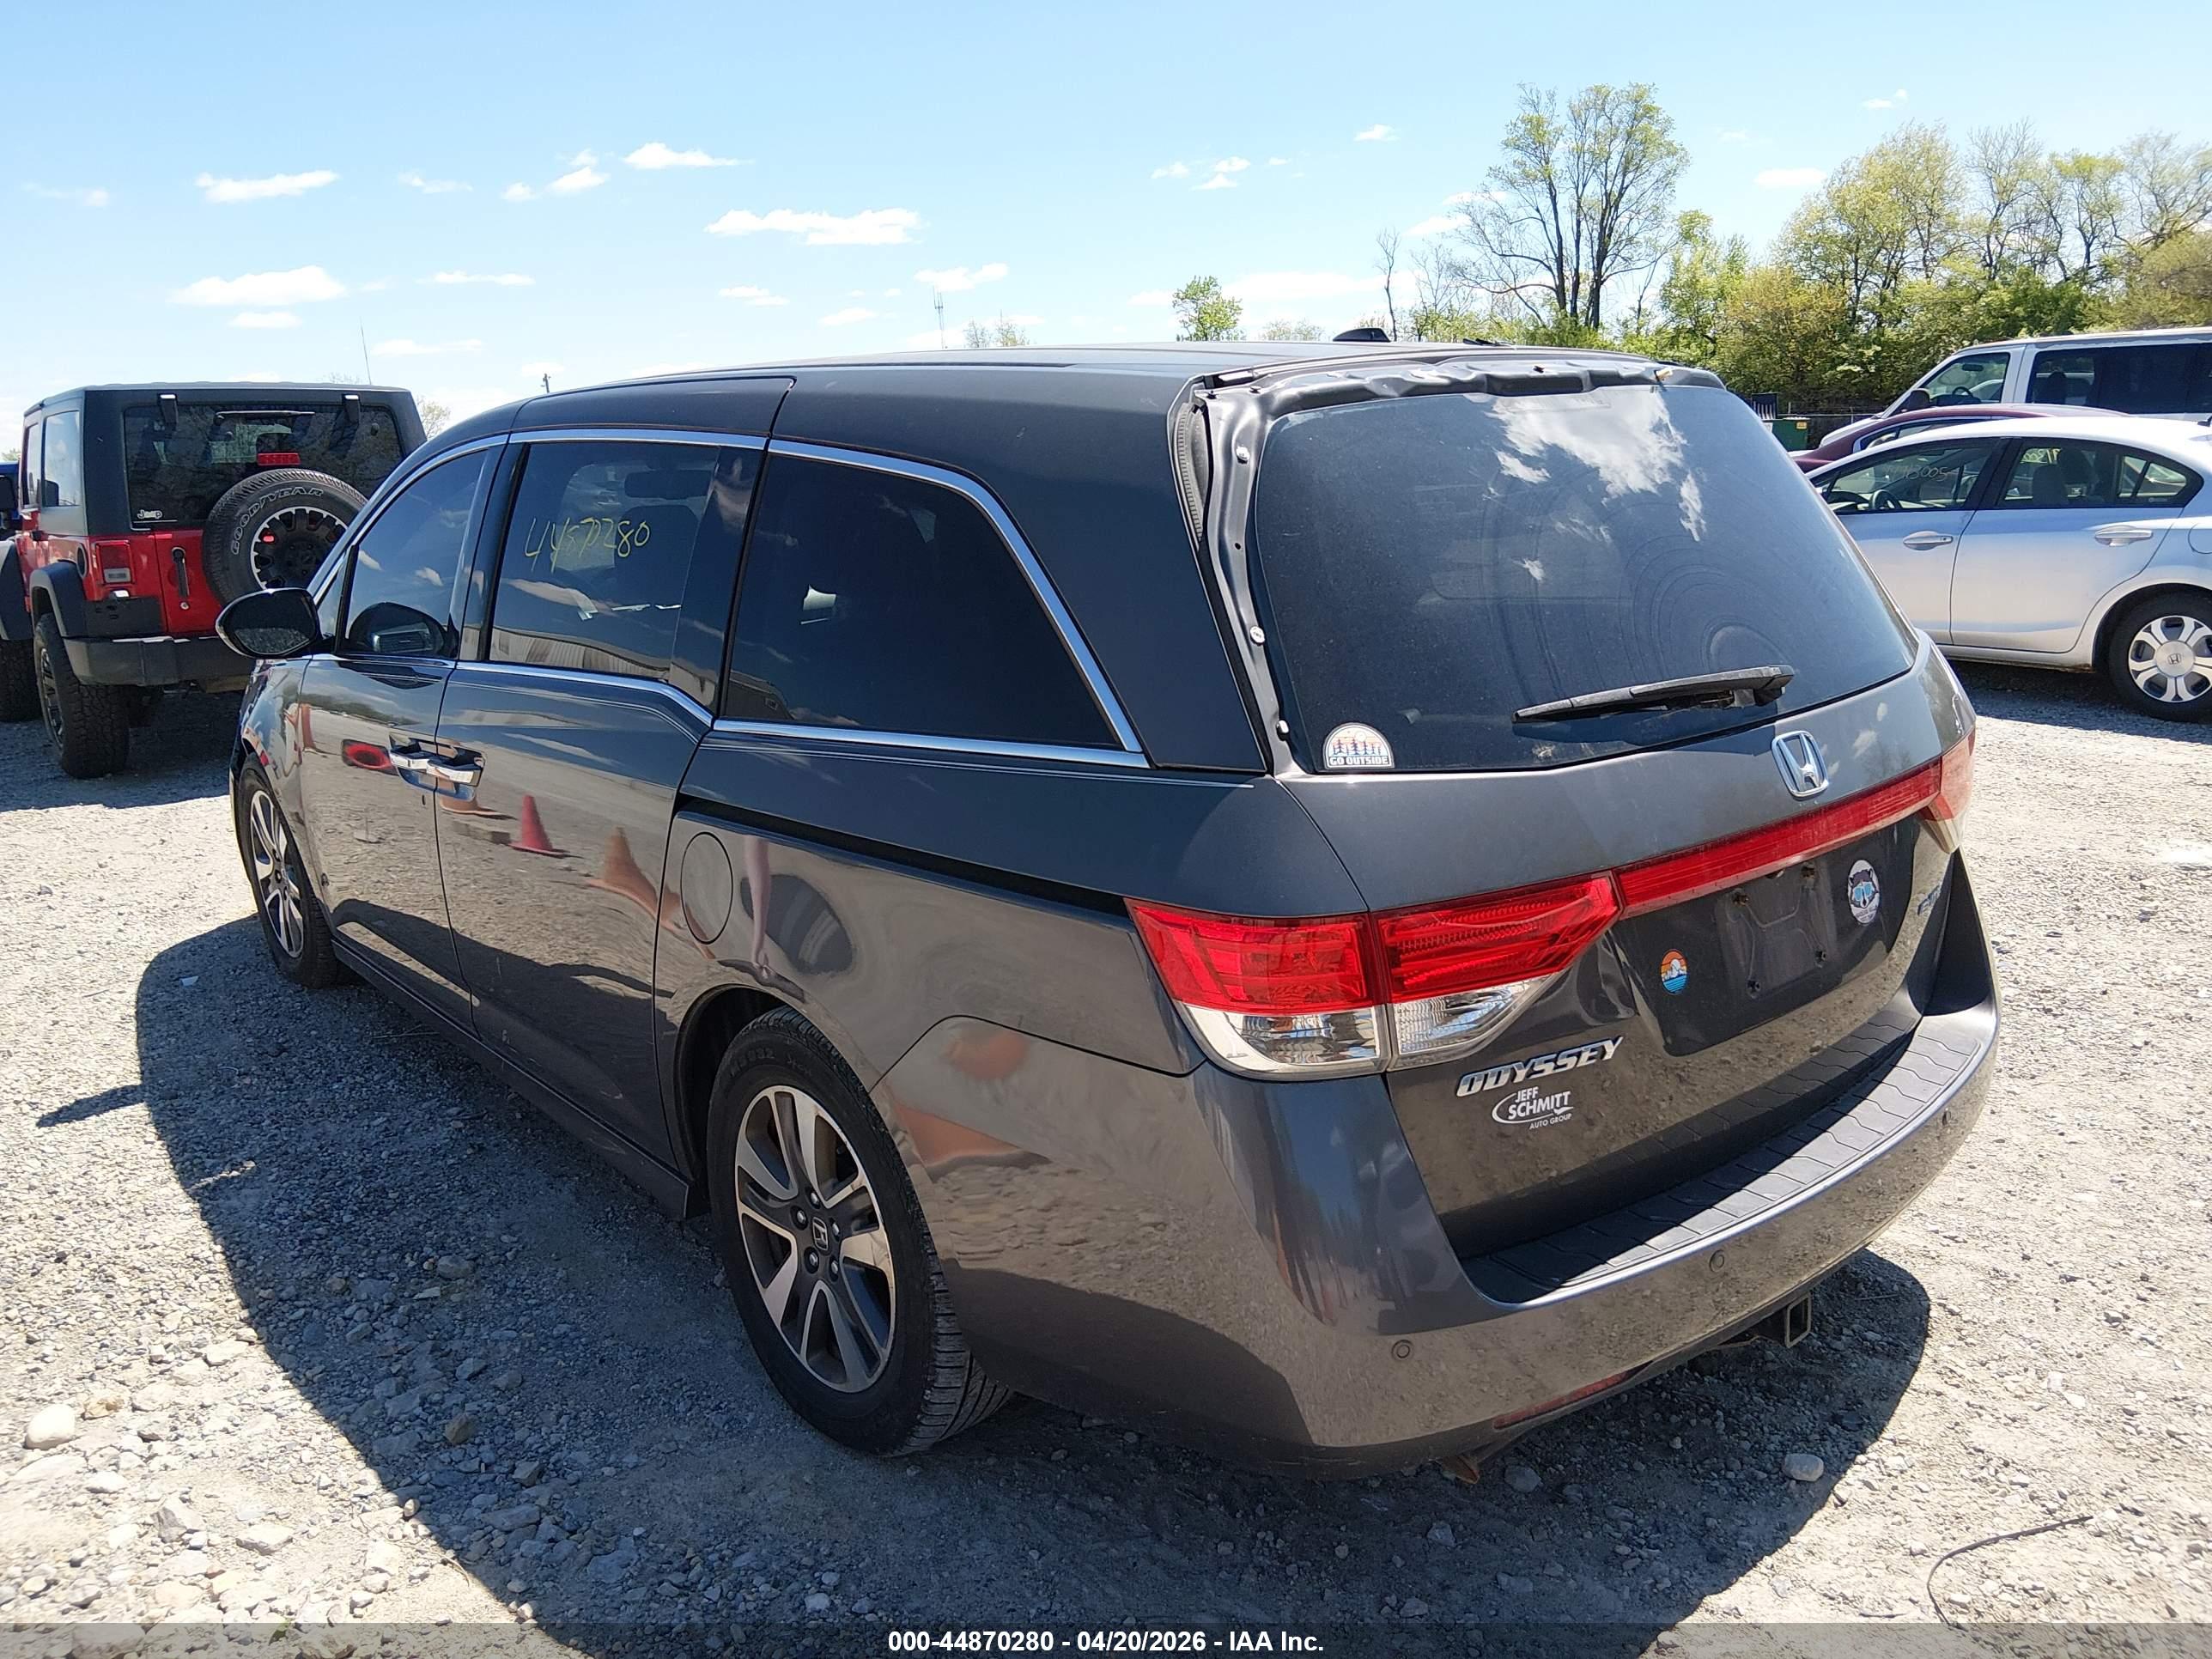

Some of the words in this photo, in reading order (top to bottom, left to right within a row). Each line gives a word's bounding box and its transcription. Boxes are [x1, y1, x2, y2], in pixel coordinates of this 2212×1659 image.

[231, 486, 324, 556] GOODYEAR
[1329, 756, 1345, 765] GO
[1346, 756, 1389, 765] OUTSIDE
[1456, 1036, 1624, 1097] ODYSSEY
[1508, 1091, 1571, 1120] SCHMITT
[1514, 1086, 1540, 1103] JEFF
[1529, 1120, 1549, 1130] AUTO
[1550, 1113, 1572, 1125] GROUP
